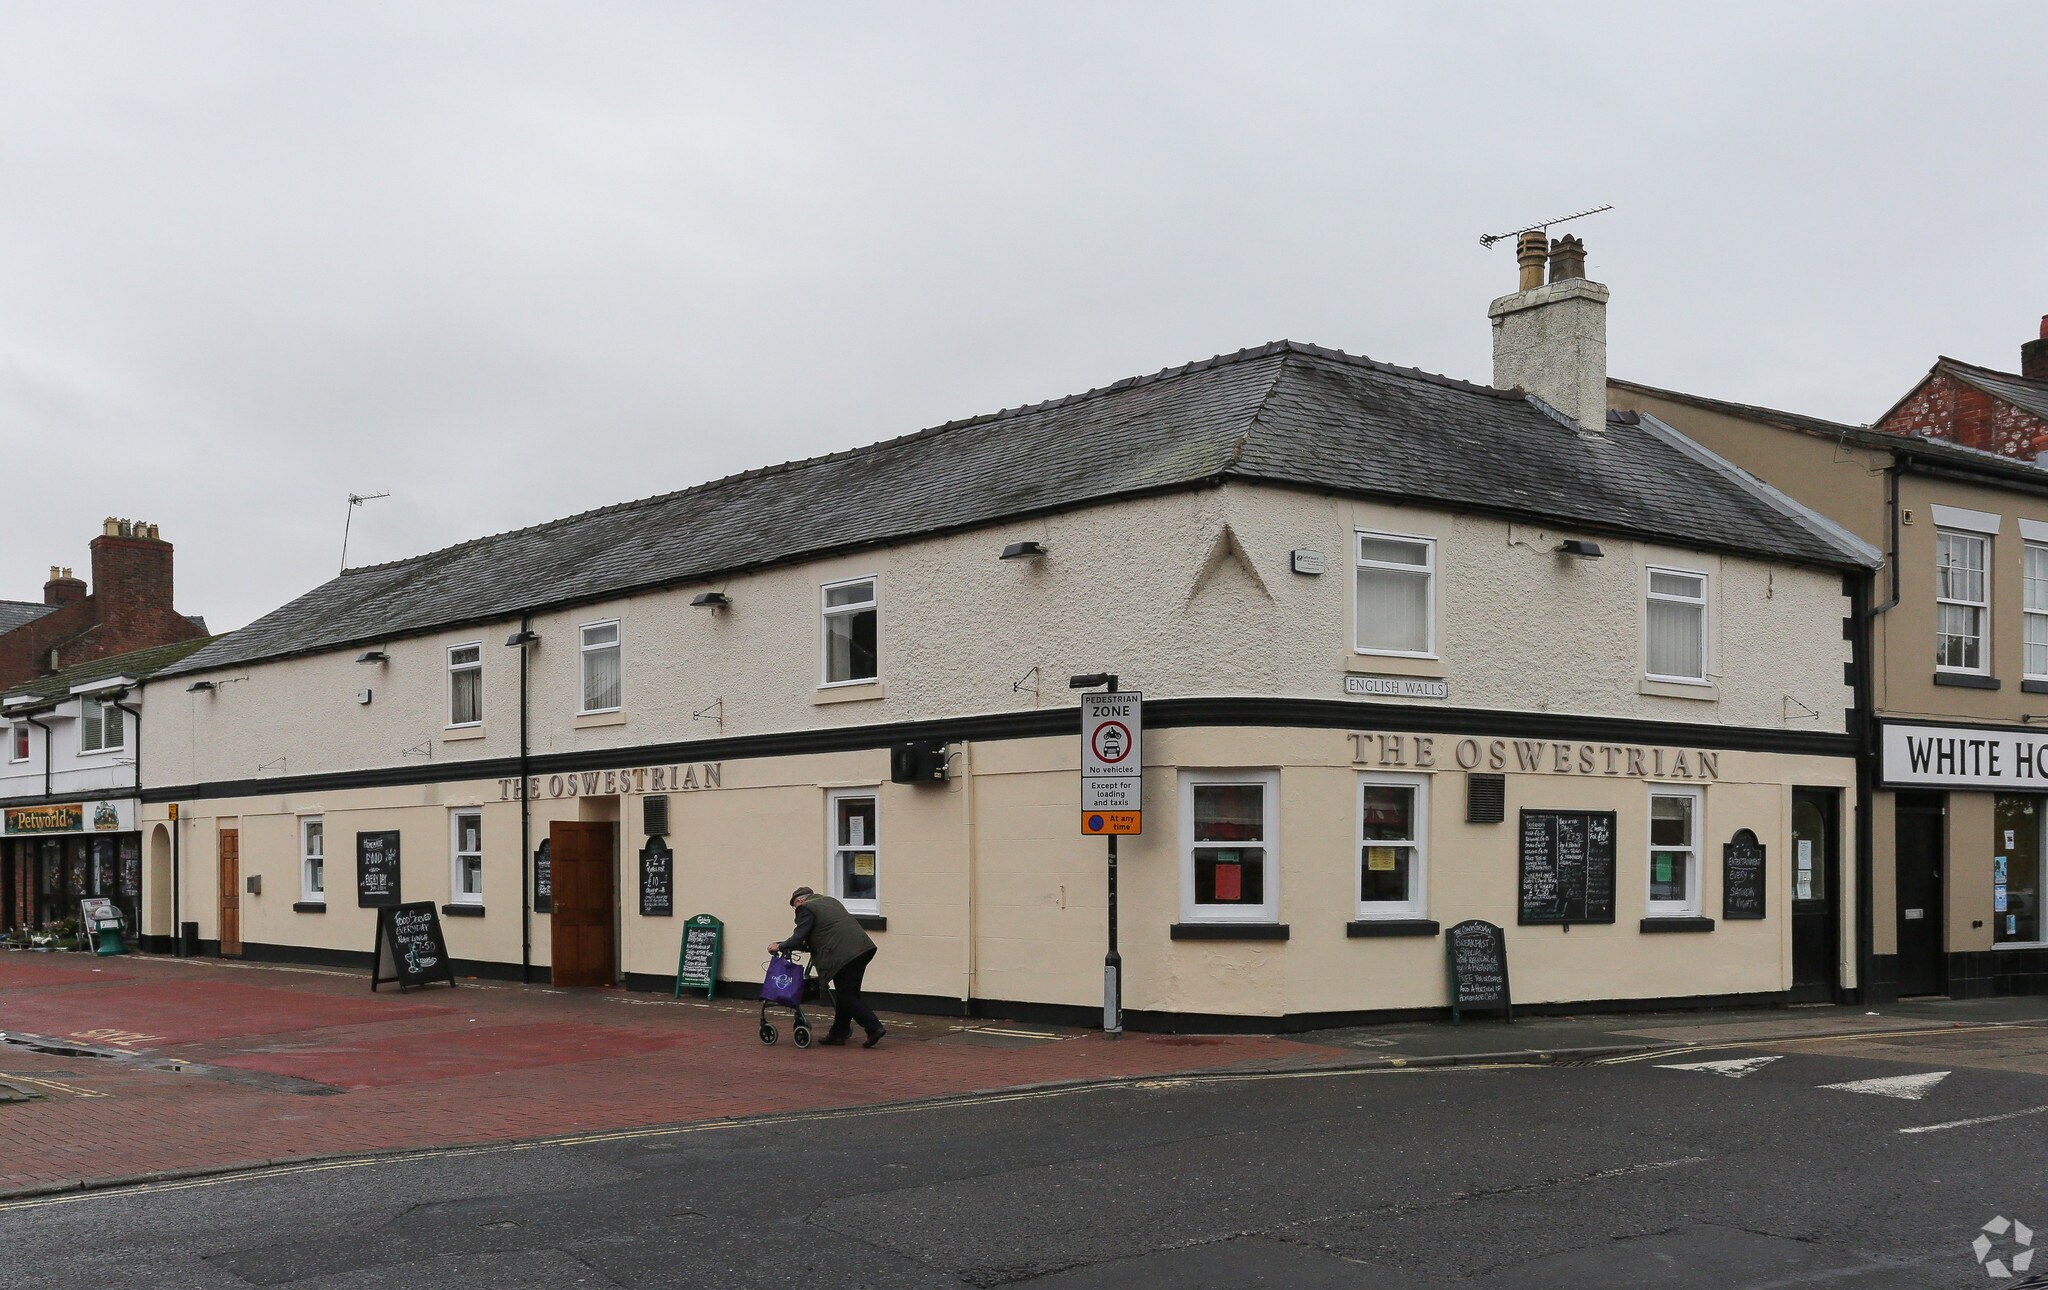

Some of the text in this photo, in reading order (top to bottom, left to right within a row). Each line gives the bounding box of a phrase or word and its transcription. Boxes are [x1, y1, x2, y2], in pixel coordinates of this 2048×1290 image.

[1349, 679, 1444, 696] ENGLISH WALLS
[1085, 695, 1138, 704] PEDESTRIAN
[1092, 705, 1130, 717] ZONE
[1347, 733, 1720, 778] THE OSWESTRIAN
[1906, 736, 2002, 776] WHITE
[499, 763, 721, 800] THE OSWESTRIAN
[1091, 782, 1118, 790] Except
[1097, 790, 1125, 798] loading
[17, 809, 67, 830] Petworld
[1455, 938, 1489, 948] BREAKFAST
